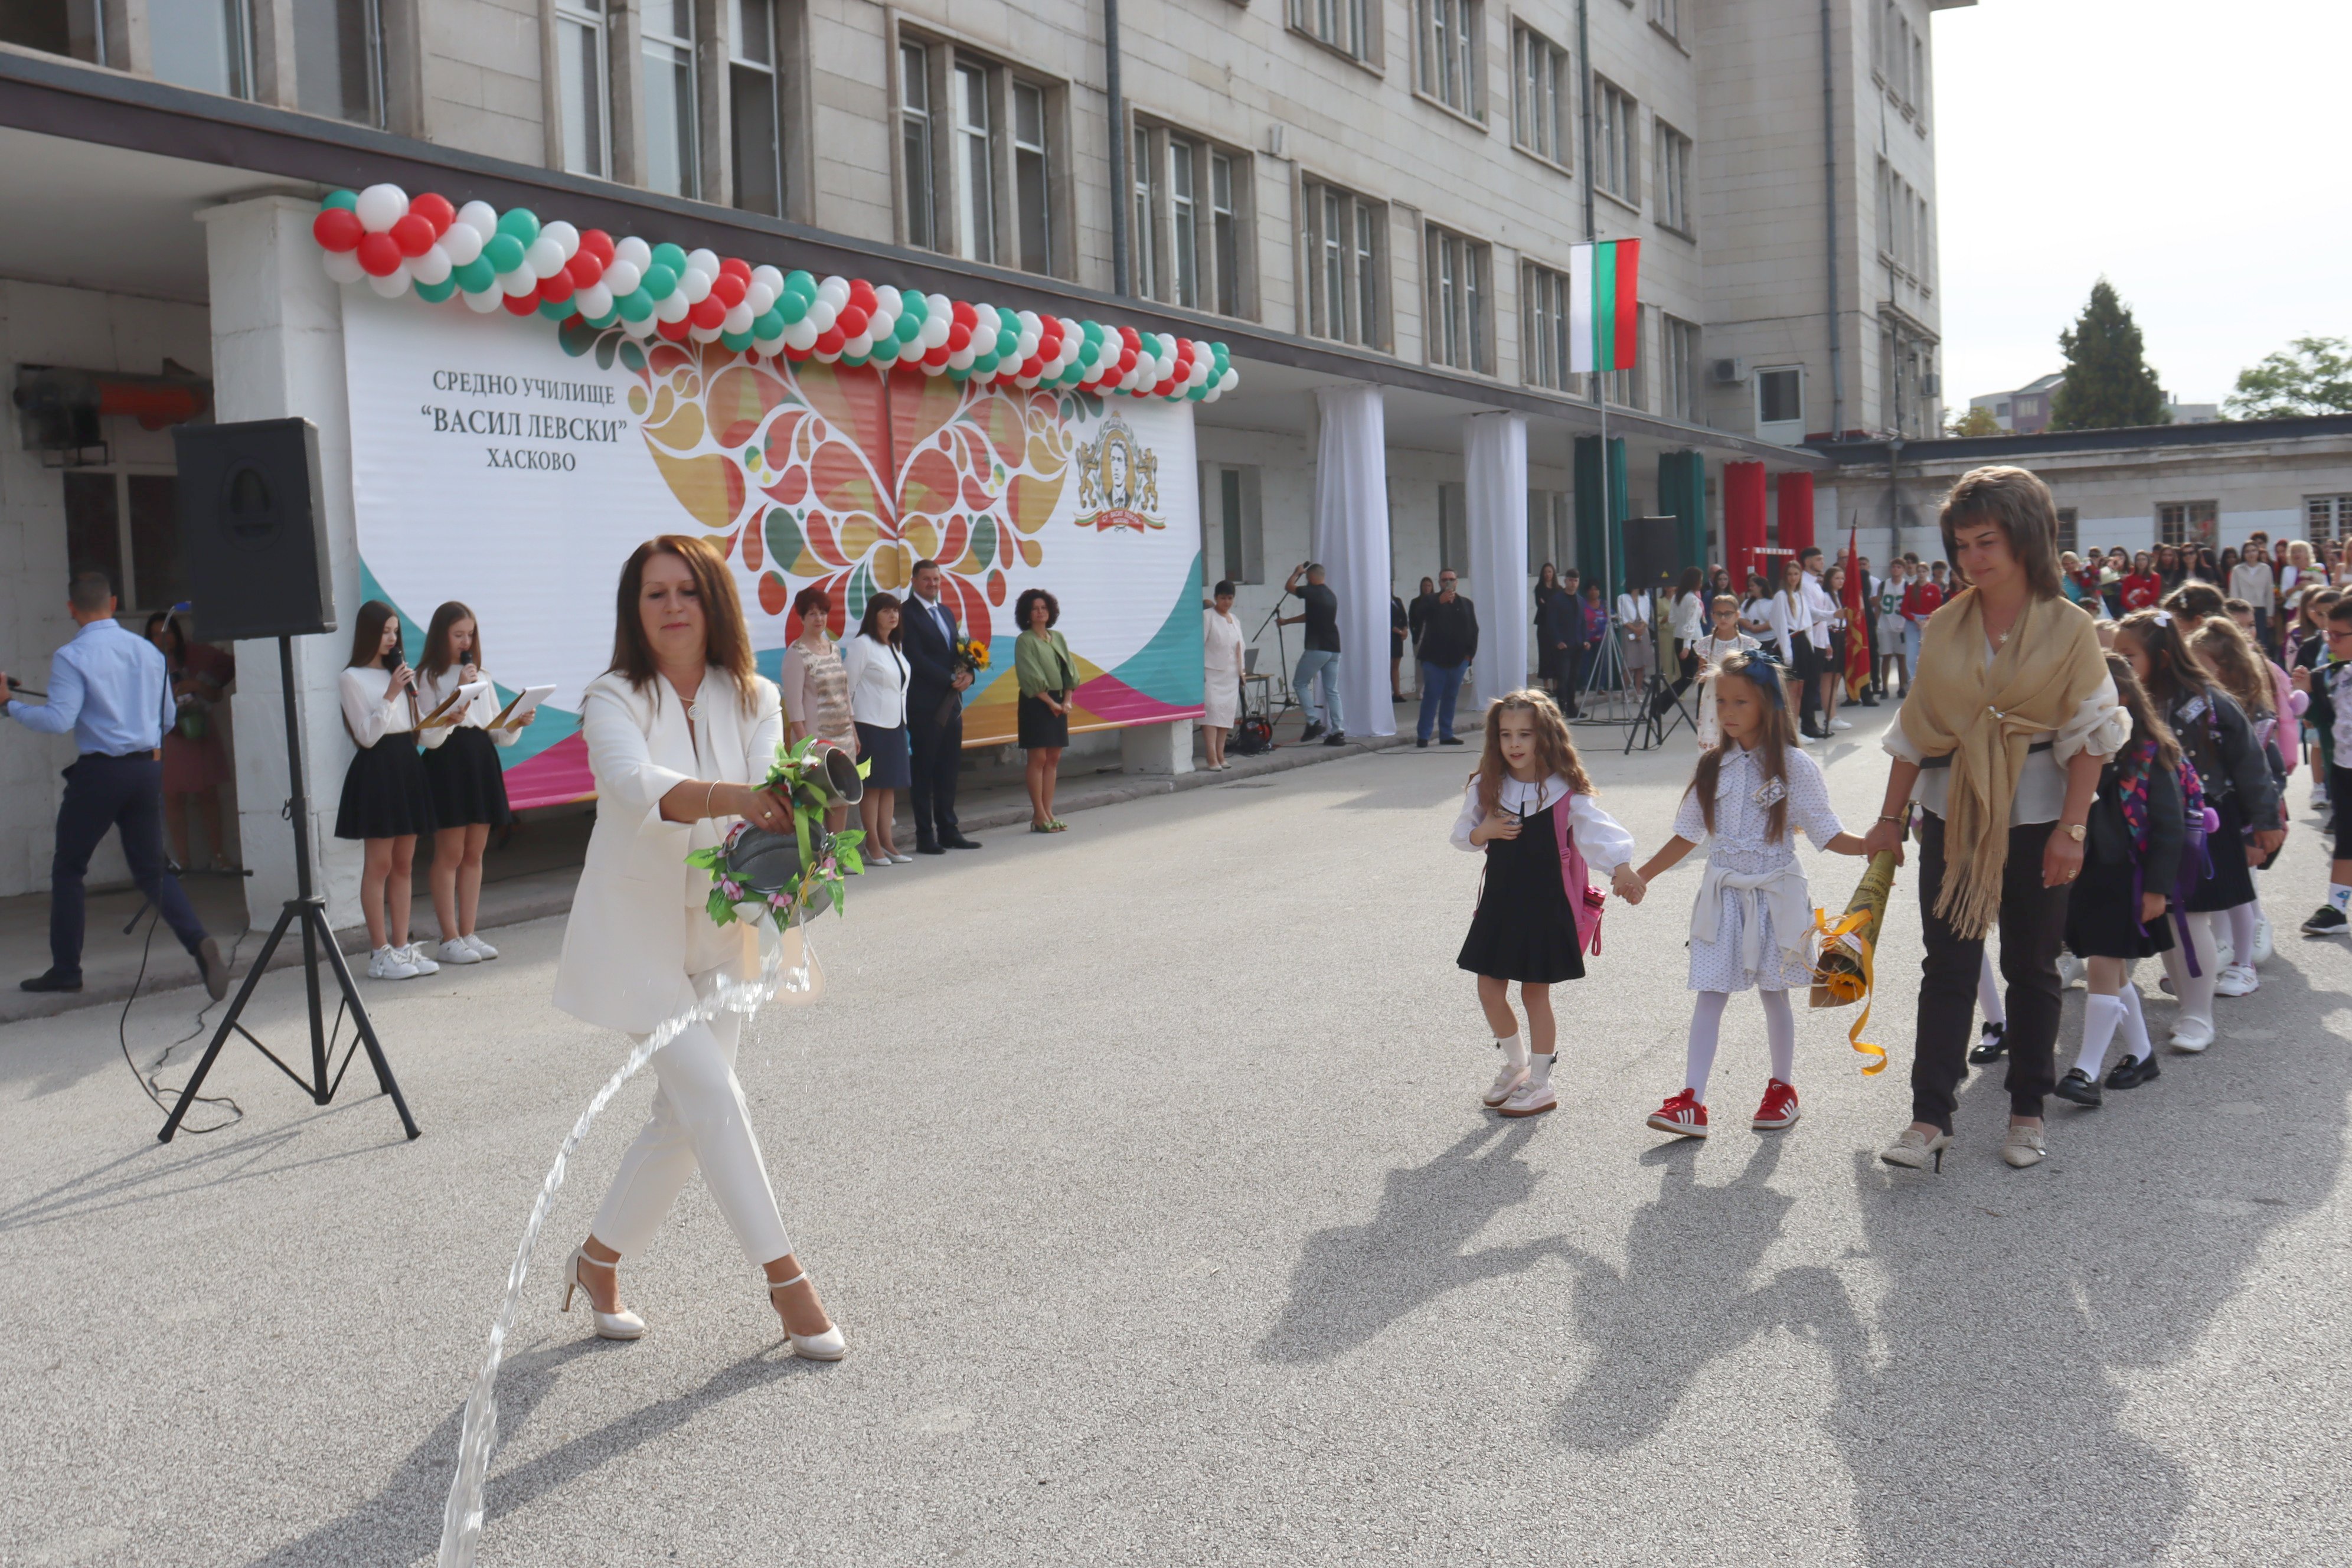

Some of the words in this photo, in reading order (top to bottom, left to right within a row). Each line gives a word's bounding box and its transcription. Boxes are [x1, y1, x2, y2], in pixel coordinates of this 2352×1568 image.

[433, 370, 517, 397] СРЕДНО
[522, 378, 616, 406] УЧИЛИЩЕ
[421, 404, 521, 437] “ВАСИЛ
[528, 414, 628, 443] ЛЕВСКИ”
[486, 448, 576, 472] ХАСКОВО
